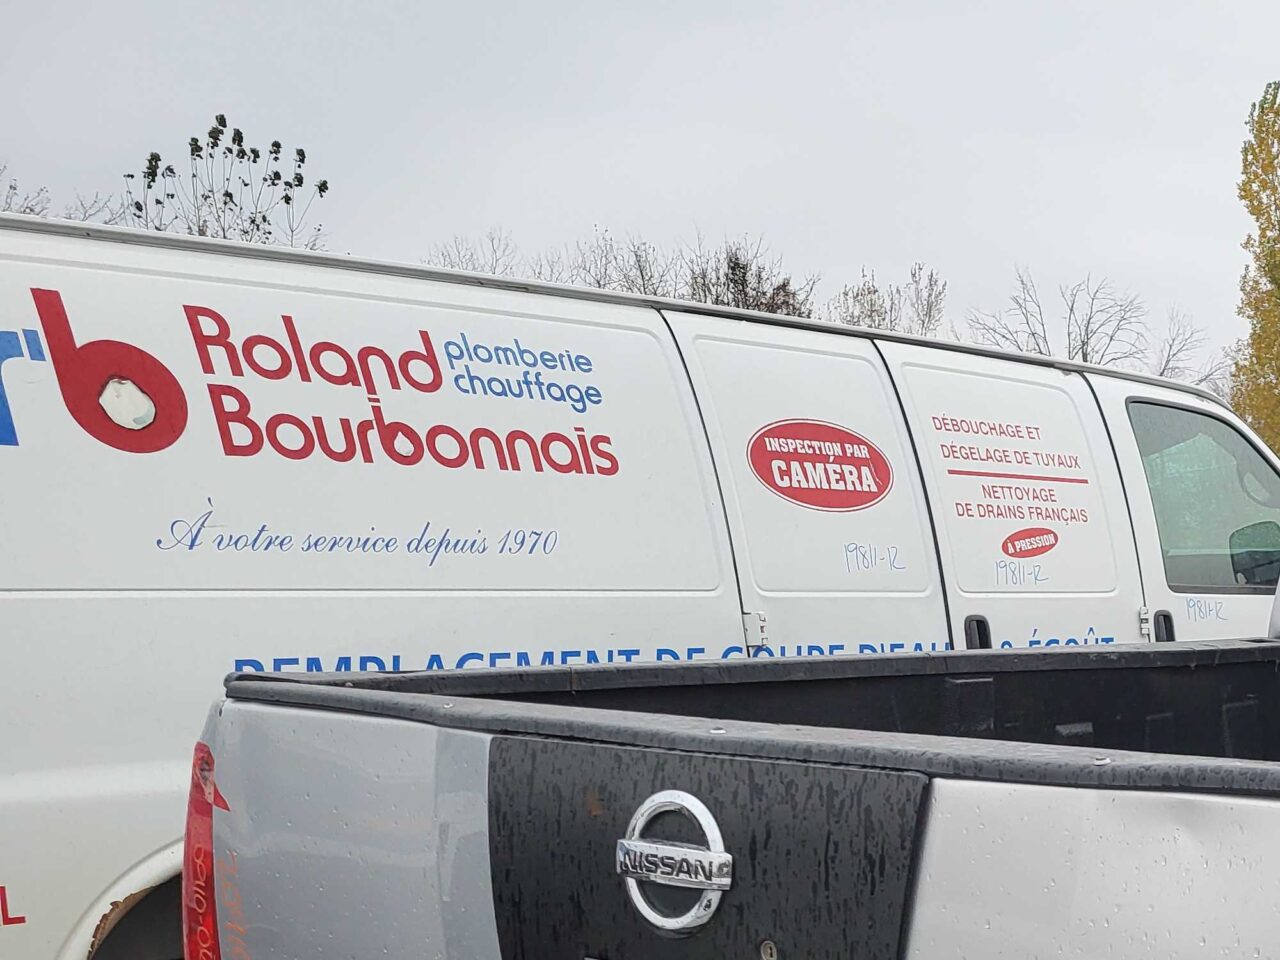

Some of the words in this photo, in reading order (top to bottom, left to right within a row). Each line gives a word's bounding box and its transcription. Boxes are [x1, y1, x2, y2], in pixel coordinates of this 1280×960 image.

[183, 304, 443, 397] Roland
[443, 332, 593, 372] plomberie
[453, 365, 603, 414] chauffage
[206, 383, 620, 477] Bourbonnais
[931, 413, 1025, 439] DÉBOUCHAGE
[1025, 426, 1041, 440] ET
[763, 437, 843, 457] INSPECTION
[844, 443, 871, 459] PAR
[940, 441, 1012, 464] DÉGELAGE
[1013, 450, 1032, 465] DE
[1032, 452, 1081, 469] TUYAUX
[771, 455, 879, 493] CAMÉRA
[981, 484, 1057, 503] NETTOYAGE
[955, 503, 975, 518] DE
[976, 503, 1026, 520] DRAINS
[1027, 506, 1089, 526] FRANÇAIS
[156, 497, 215, 551] À
[213, 523, 296, 553] votre
[300, 526, 400, 554] service
[405, 521, 489, 568] depuis
[497, 529, 559, 556] 1970
[1014, 533, 1056, 553] PRESSION
[620, 850, 714, 882] NISSAN
